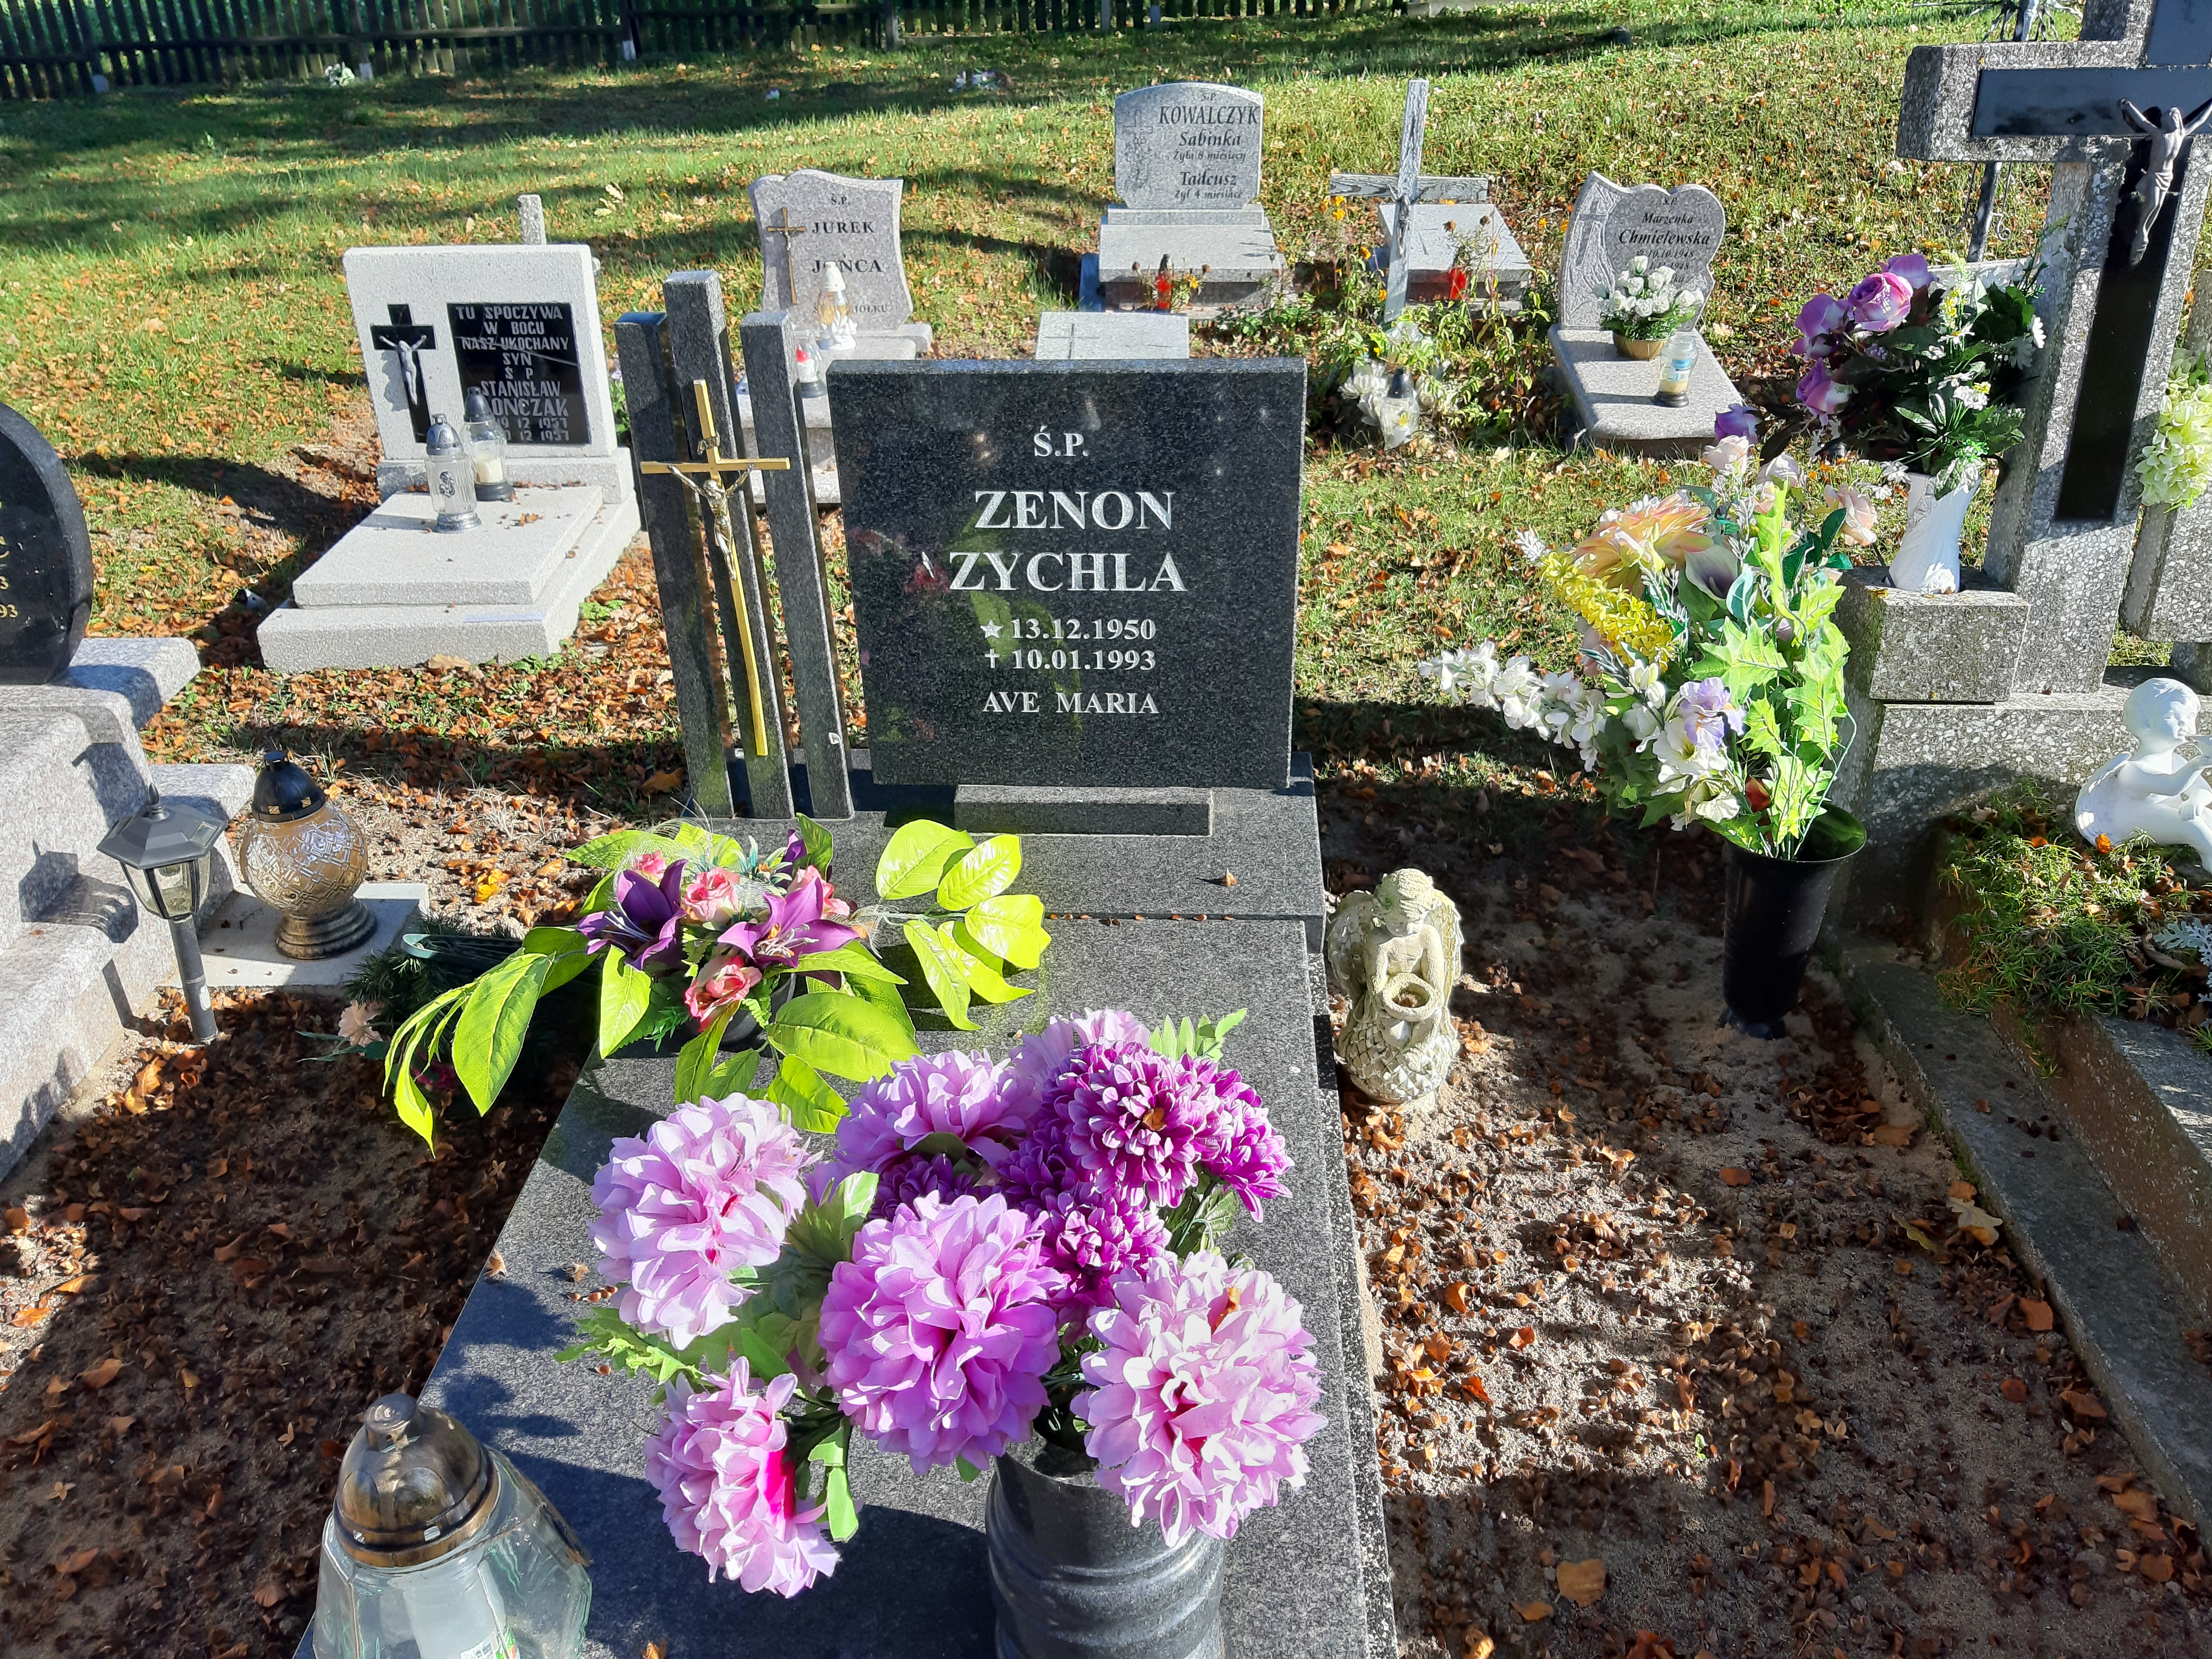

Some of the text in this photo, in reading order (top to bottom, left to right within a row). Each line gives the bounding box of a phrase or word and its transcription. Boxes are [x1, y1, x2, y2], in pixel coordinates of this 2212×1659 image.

[1158, 105, 1260, 124] KOWALCZYK
[1179, 128, 1242, 146] Sabinka
[1180, 168, 1237, 186] Tadeusz
[1194, 190, 1200, 199] 4
[1641, 212, 1695, 224] Marzenka
[812, 221, 875, 234] JUREK
[1619, 229, 1710, 245] Chmielewska
[456, 305, 564, 320] TU SPOCZYWA
[483, 321, 545, 335] W BOGU
[461, 337, 569, 351] NASZ UKOCHANY
[502, 352, 533, 366] SYN
[526, 367, 534, 380] P
[480, 380, 561, 397] STANISŁAW
[517, 417, 531, 429] 12
[520, 430, 533, 442] 12
[1033, 425, 1090, 457] Ś.P.
[974, 490, 1176, 530] ZENON
[949, 551, 1189, 592] ZYCHLA
[1010, 617, 1156, 640] 13.12.1950
[1011, 648, 1156, 671] 10.01.1993
[981, 690, 1160, 714] AVE MARIA
